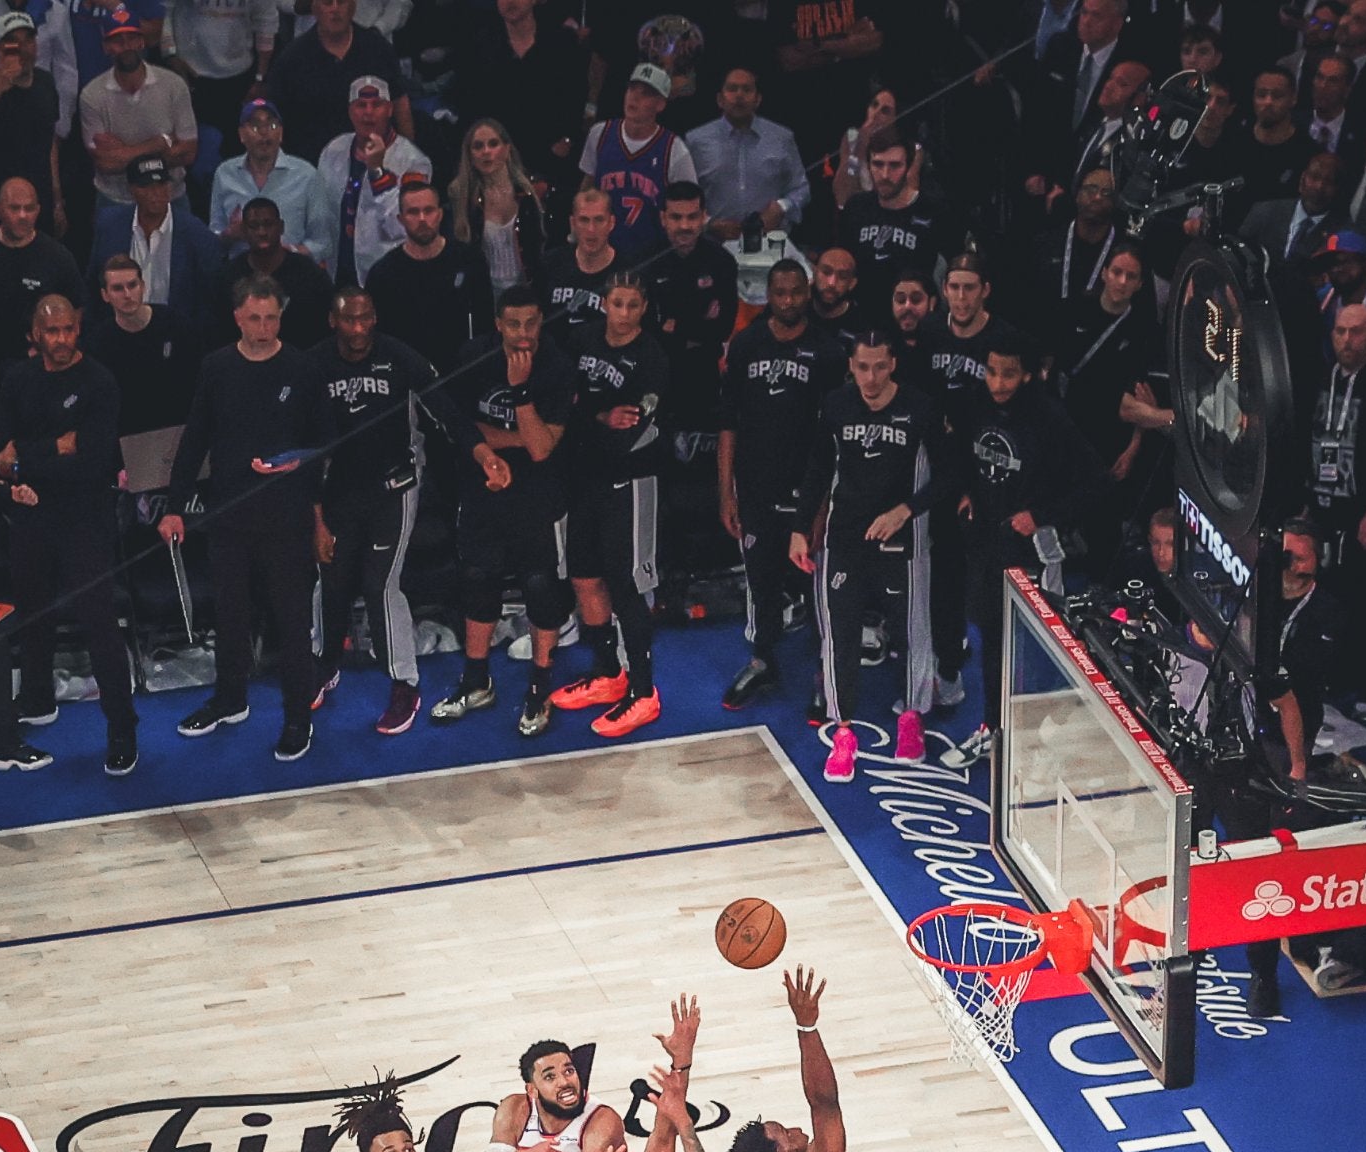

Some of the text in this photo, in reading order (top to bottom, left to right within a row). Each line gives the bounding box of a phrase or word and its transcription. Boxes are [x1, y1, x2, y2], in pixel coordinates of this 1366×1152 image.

[622, 196, 644, 226] 7
[843, 424, 907, 448] SPURS
[1199, 511, 1251, 598] TISSOT
